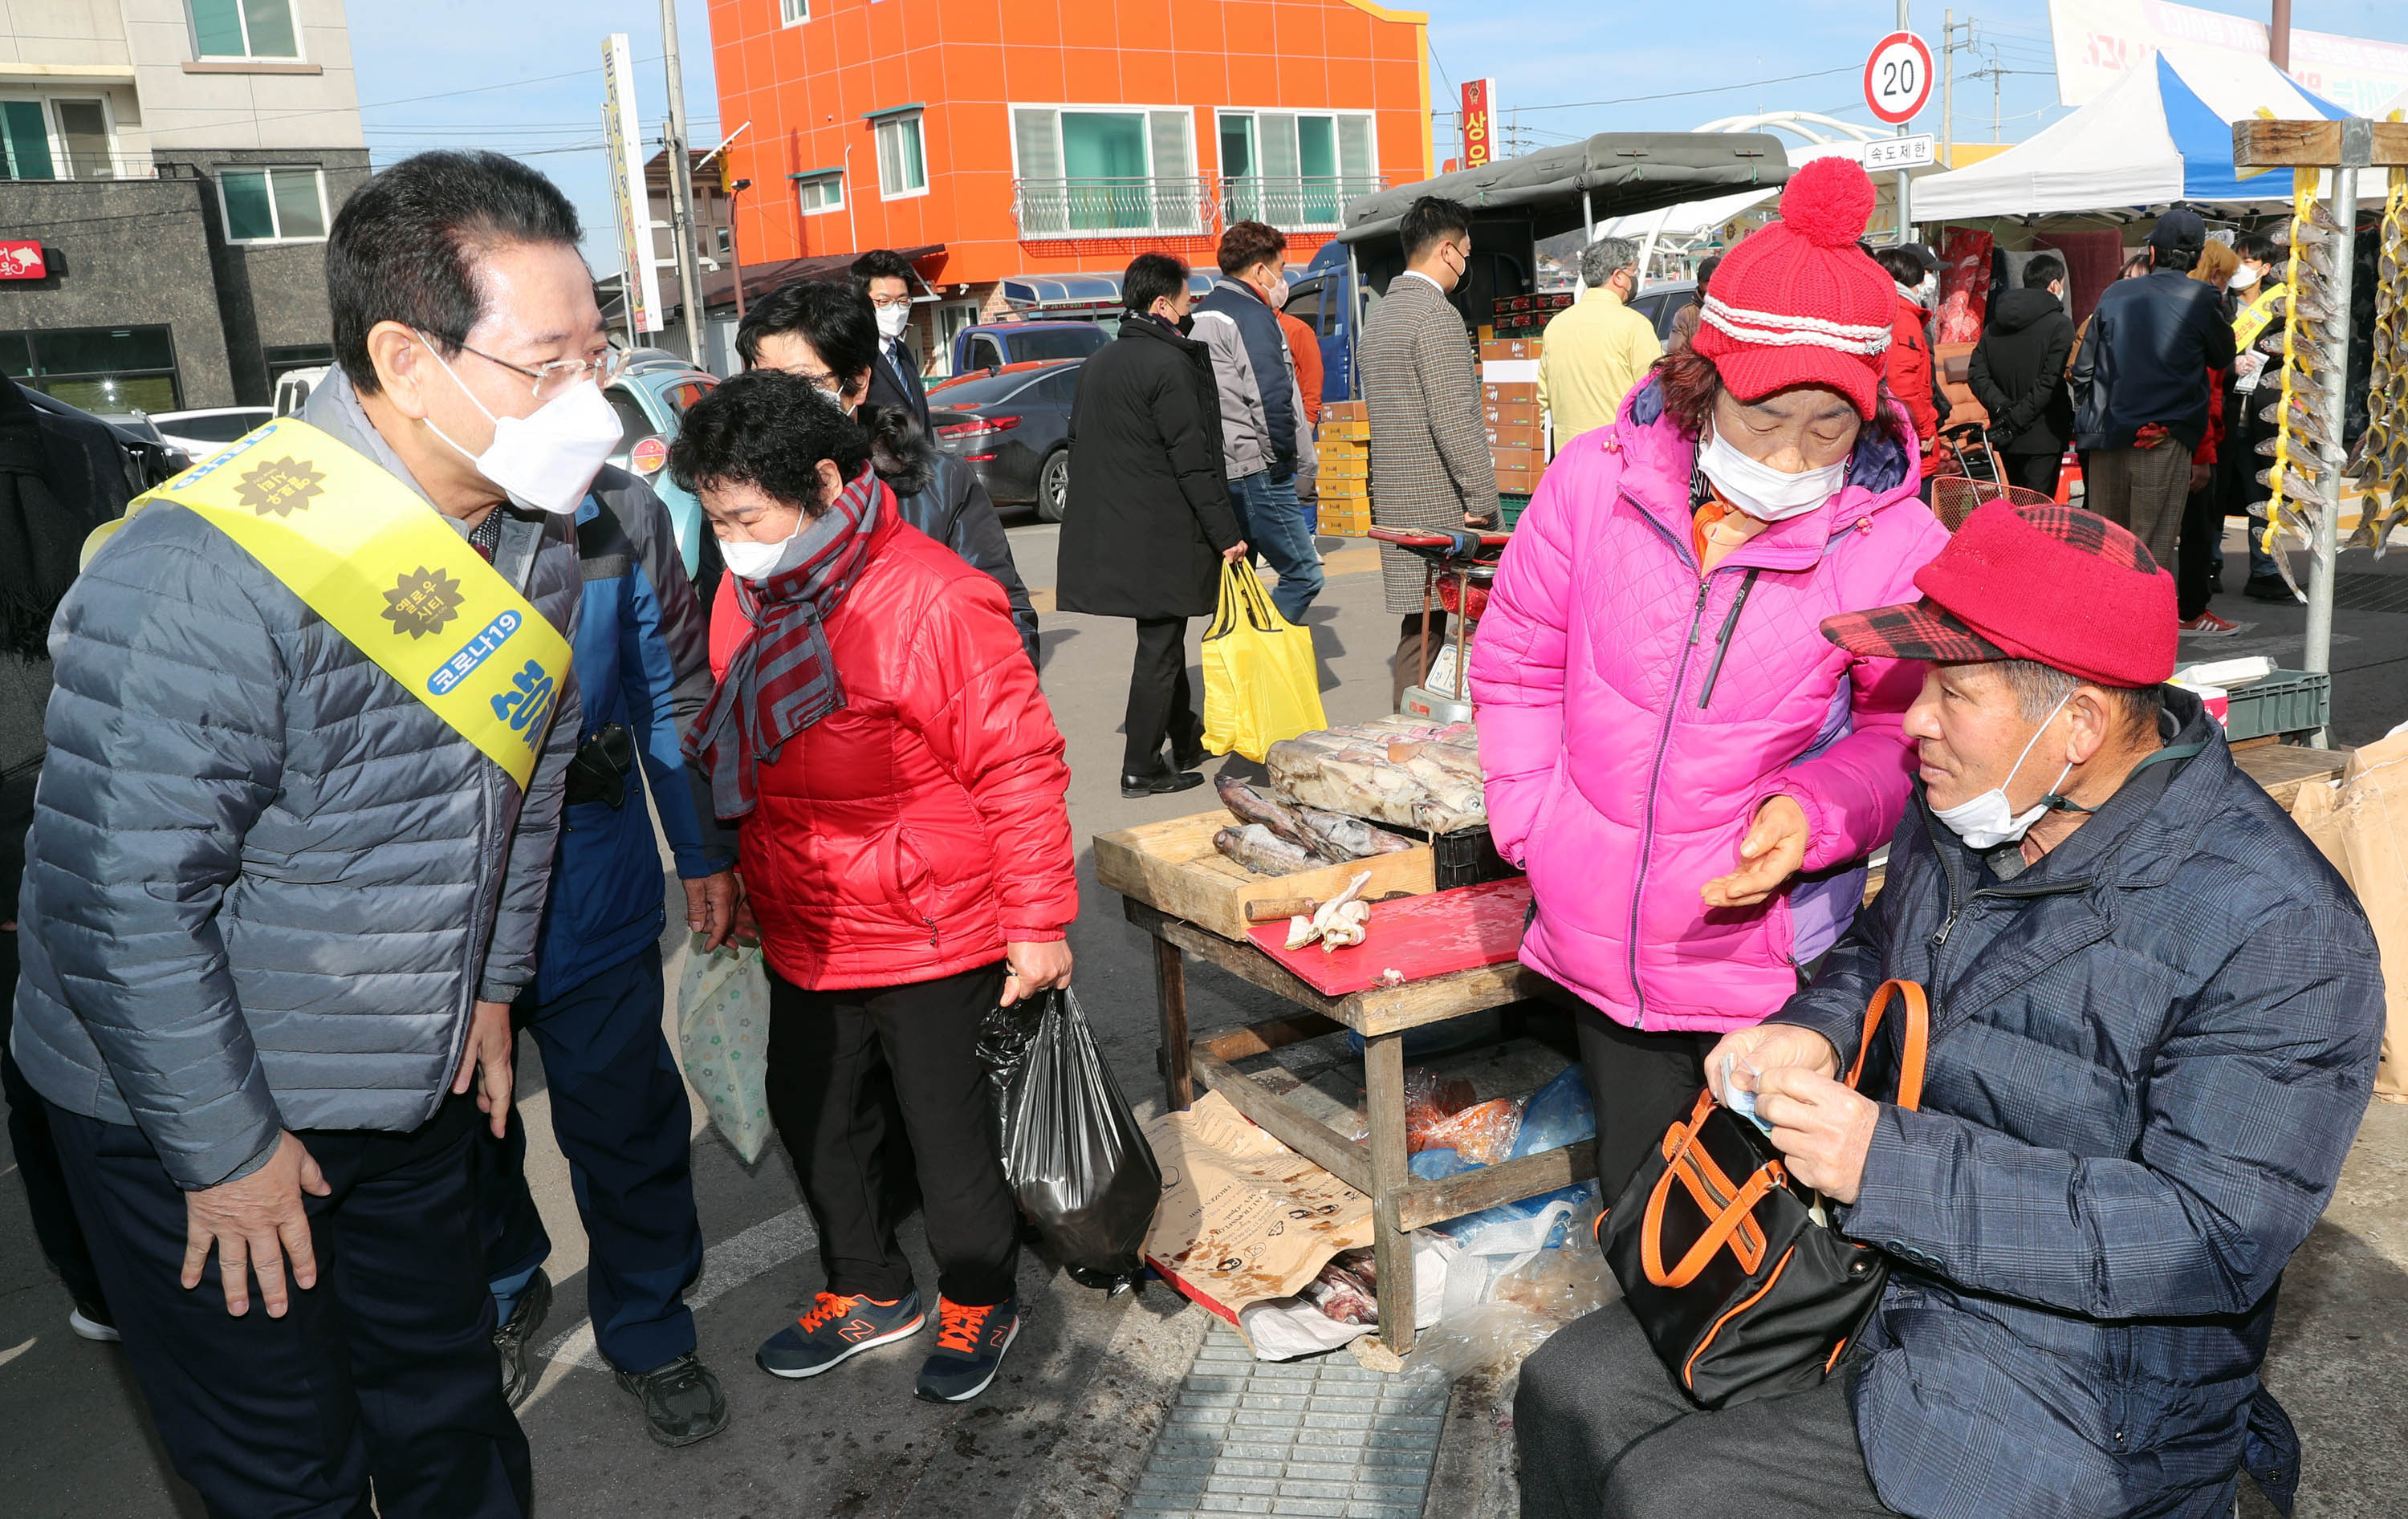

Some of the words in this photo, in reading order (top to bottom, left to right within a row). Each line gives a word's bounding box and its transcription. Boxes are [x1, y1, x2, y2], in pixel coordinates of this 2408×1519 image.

[1884, 59, 1914, 96] 20
[1871, 142, 1926, 161] 속도제한
[395, 580, 437, 615] 옐로우
[417, 596, 445, 621] 시티
[432, 614, 517, 692] 코로나19
[1188, 1204, 1205, 1219] FISH
